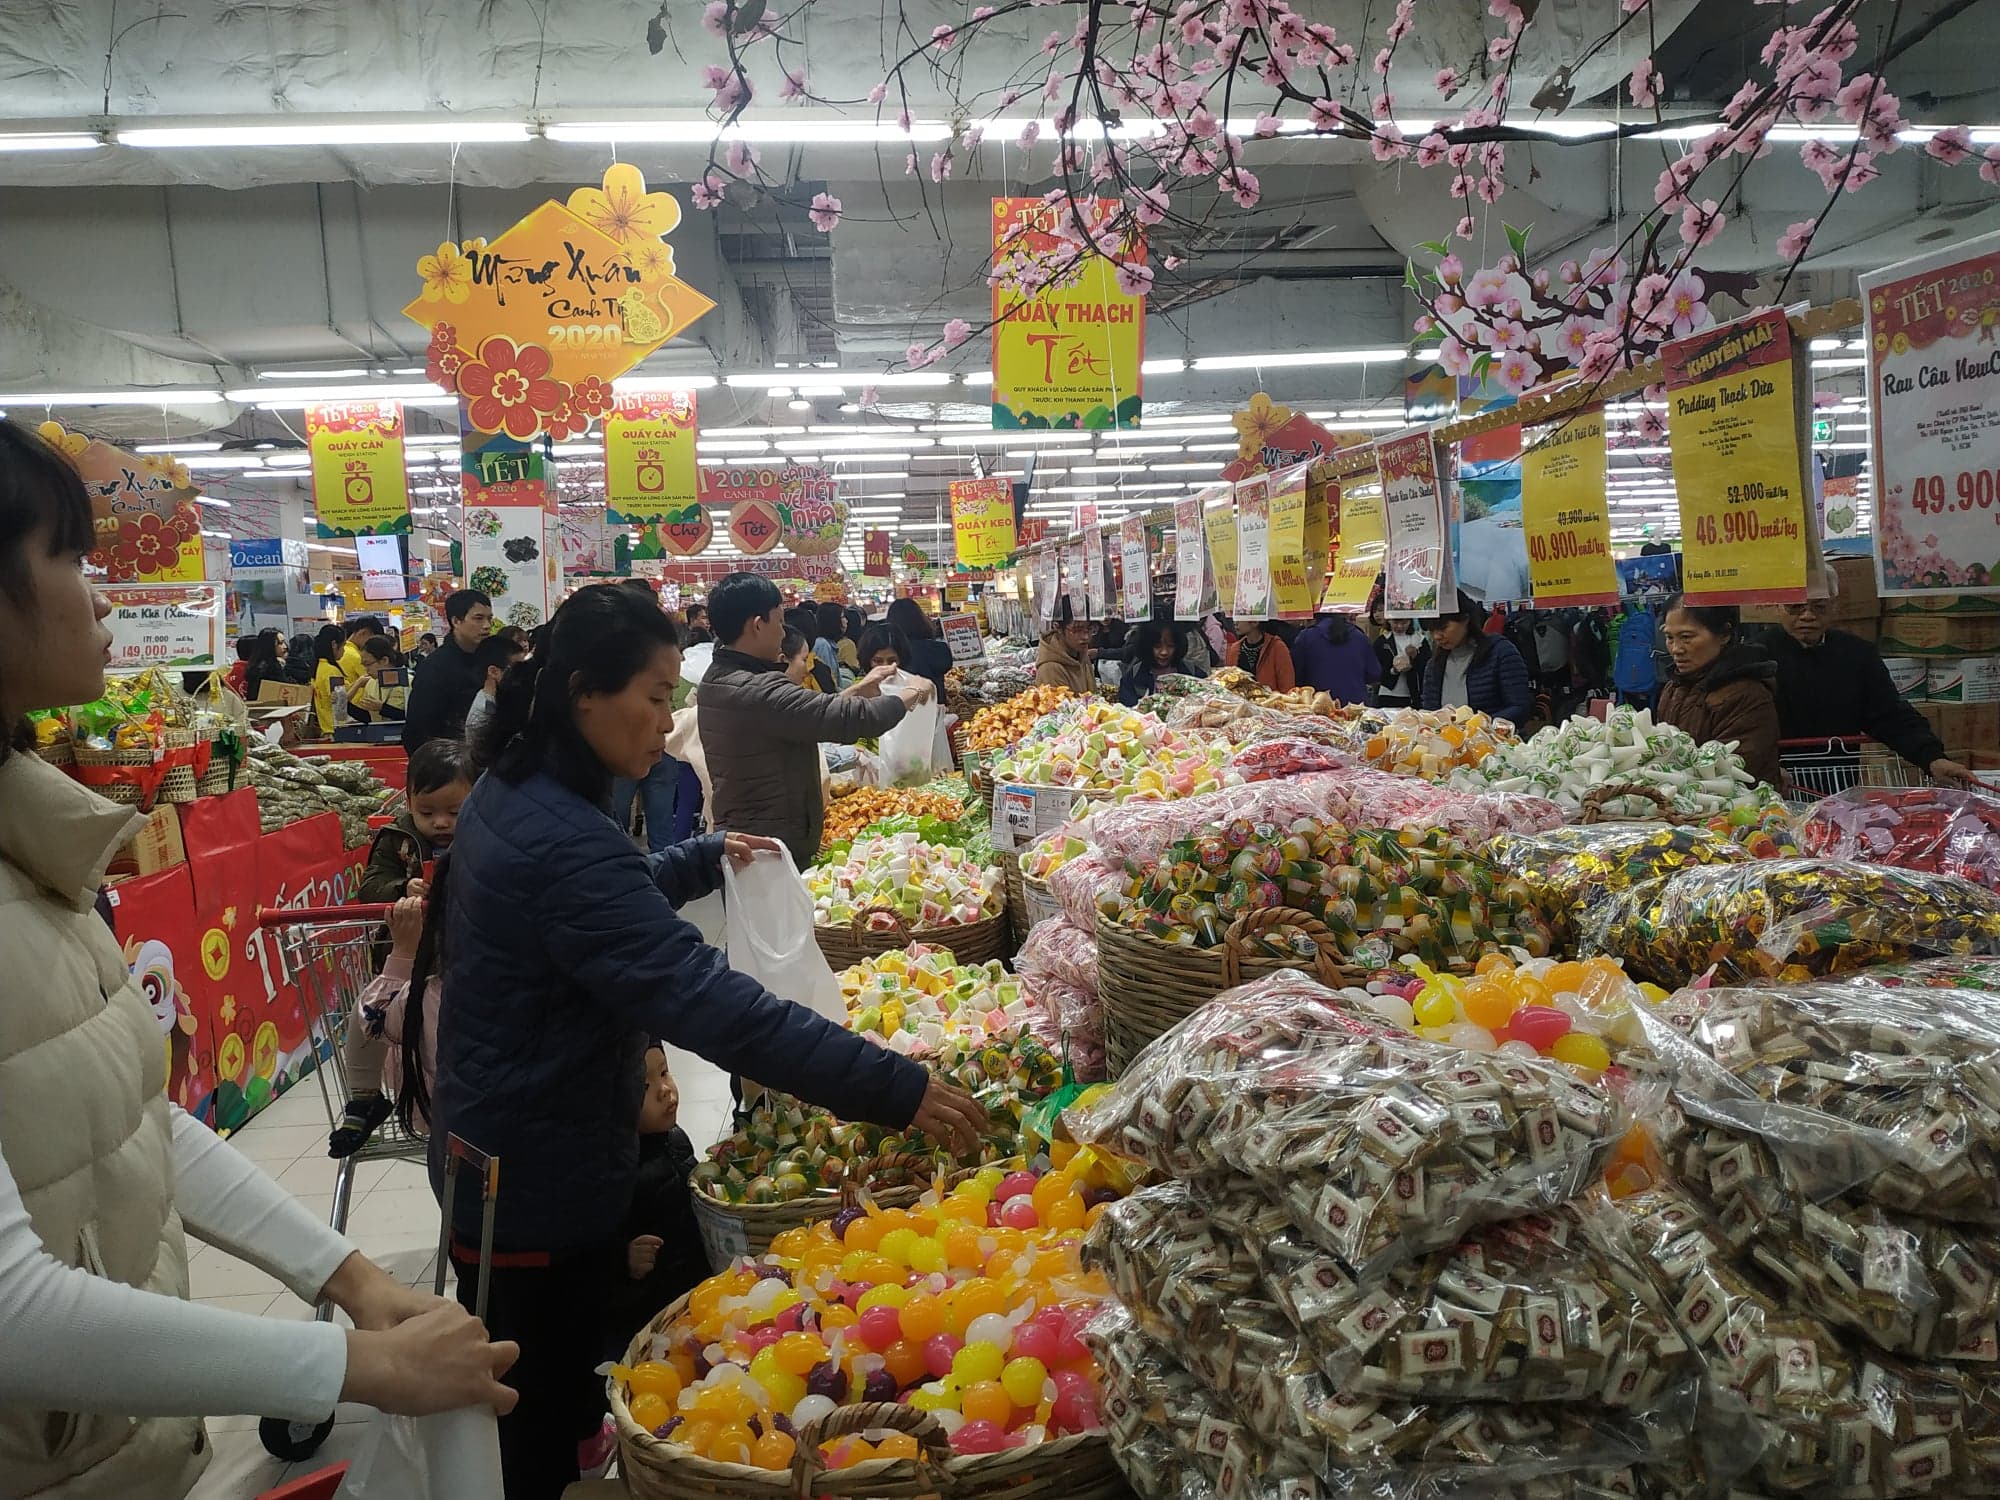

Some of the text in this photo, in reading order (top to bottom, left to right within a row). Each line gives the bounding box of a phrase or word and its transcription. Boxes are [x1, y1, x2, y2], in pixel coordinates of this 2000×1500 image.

[564, 242, 641, 295] Xuân
[1895, 269, 1993, 326] TẾT 2020
[548, 299, 600, 318] Canh
[1066, 303, 1134, 327] THẠCH
[548, 324, 622, 349] 2020
[1027, 333, 1110, 384] Tết
[1883, 373, 1914, 396] Rau
[1919, 366, 1950, 389] Câu
[645, 393, 669, 403] 2020
[1677, 396, 1716, 417] Pudding
[1719, 387, 1747, 409] Thạch
[350, 404, 374, 414] 2020
[475, 453, 528, 483] TẾT
[490, 485, 518, 493] 2020
[715, 471, 774, 488] 2020
[740, 521, 769, 536] Tết
[1696, 510, 1759, 546] 46.900
[1530, 531, 1577, 562] 40.900
[233, 551, 281, 566] Ocean
[750, 560, 789, 571] 2020
[114, 590, 151, 600] TẾT
[119, 608, 137, 620] Nho
[142, 608, 160, 619] Khô
[123, 645, 168, 657] 149.000
